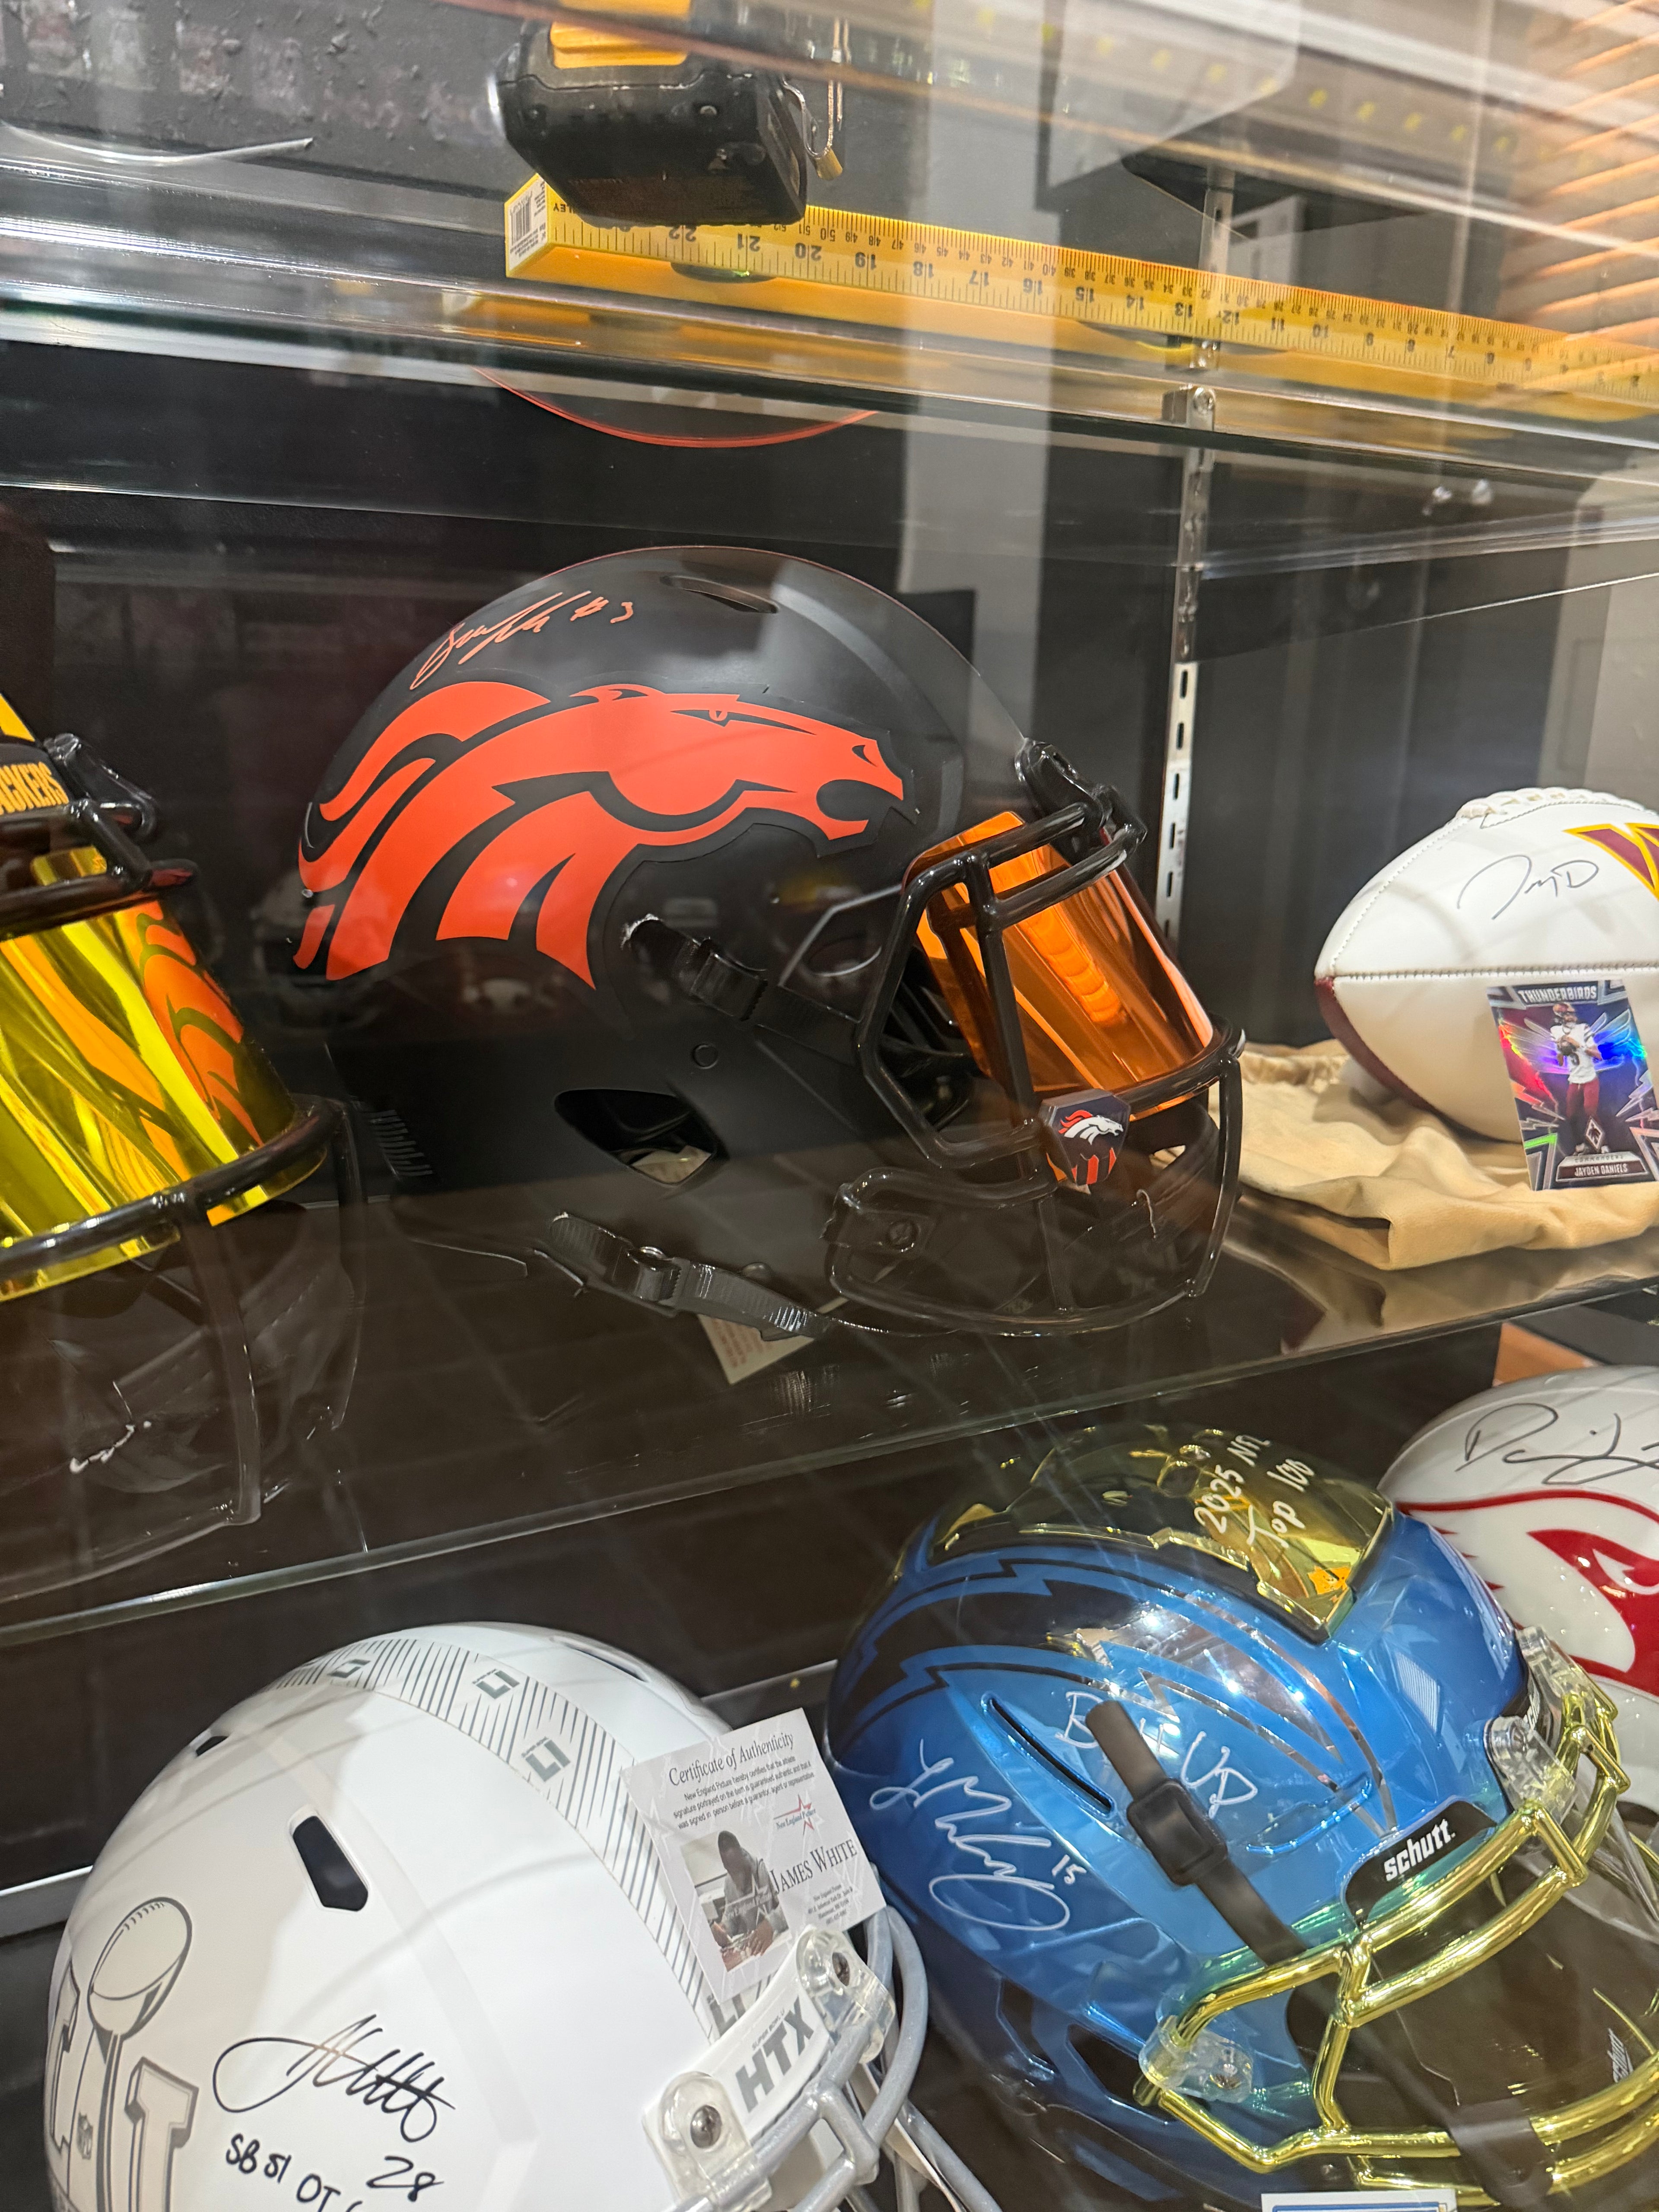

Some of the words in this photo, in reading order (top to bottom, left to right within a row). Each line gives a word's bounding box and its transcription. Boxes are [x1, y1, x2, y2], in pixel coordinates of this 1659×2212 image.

[669, 225, 696, 242] 22
[799, 224, 810, 235] 51
[821, 228, 835, 242] 50
[845, 230, 858, 243] 49
[738, 232, 760, 252] 21
[869, 235, 880, 247] 48
[892, 239, 903, 250] 47
[914, 242, 926, 254] 46
[795, 242, 822, 261] 20
[937, 246, 948, 257] 45
[959, 250, 970, 261] 44
[980, 253, 992, 264] 43
[855, 252, 877, 270] 19
[1002, 257, 1013, 268] 42
[1023, 260, 1034, 270] 41
[913, 261, 934, 278] 18
[1043, 264, 1056, 276] 40
[1065, 267, 1075, 278] 39
[1085, 270, 1096, 281] 38
[969, 270, 989, 286] 17
[1105, 274, 1116, 285] 37
[1023, 278, 1042, 295] 16
[1076, 286, 1094, 302] 15
[1126, 294, 1144, 311] 14
[1175, 302, 1192, 318] 13
[1222, 310, 1239, 325] 12
[1271, 318, 1284, 332] 11
[1313, 324, 1329, 338] 10
[1518, 986, 1597, 1003] THUNDERBIRDS
[1574, 1167, 1600, 1177] JAYDEN
[1601, 1163, 1628, 1175] DANIELS
[1194, 1465, 1245, 1534] 2025
[670, 1760, 724, 1786] Certificate
[726, 1749, 737, 1769] of
[740, 1732, 793, 1763] Authenticity
[684, 1791, 696, 1801] New
[696, 1784, 716, 1796] England
[1384, 1818, 1452, 1881] schutt
[770, 1860, 813, 1894] JAMES
[810, 1839, 857, 1872] WHITE
[1052, 1854, 1087, 1885] 15
[735, 1996, 814, 2113] HTX
[226, 2133, 260, 2174] SB
[365, 2155, 444, 2202] 28
